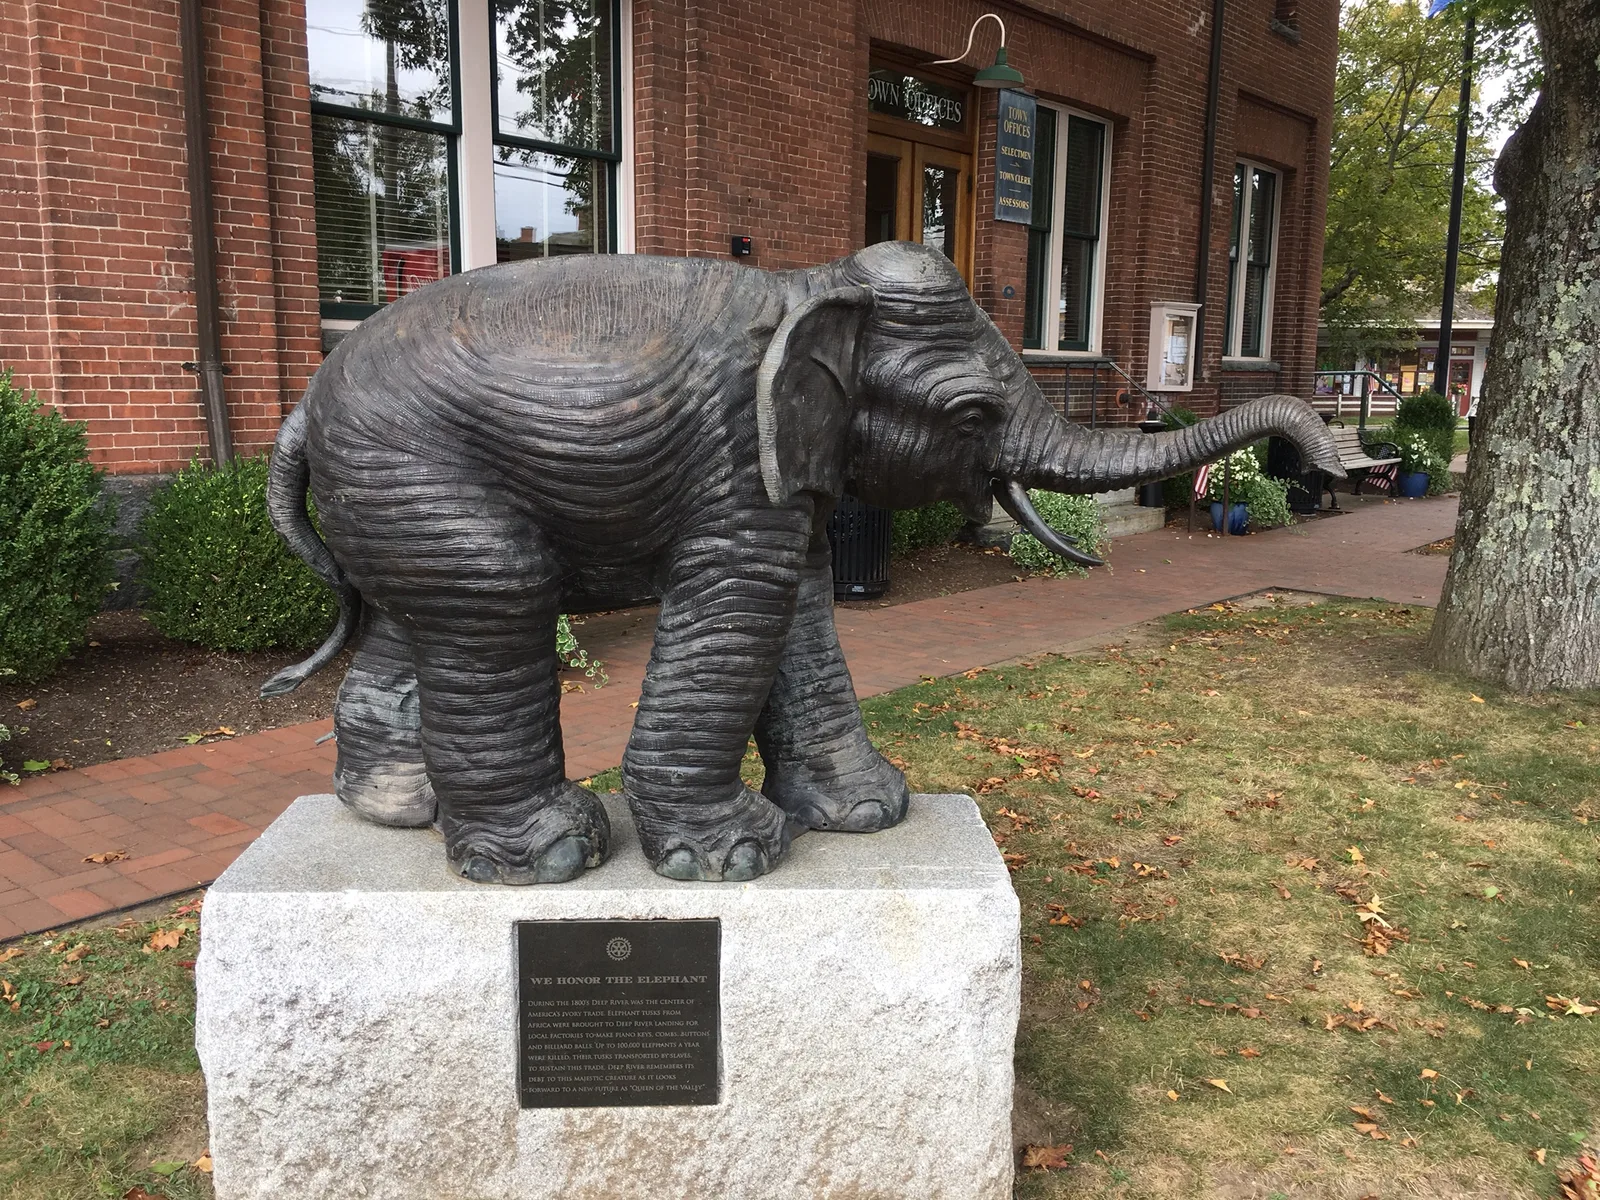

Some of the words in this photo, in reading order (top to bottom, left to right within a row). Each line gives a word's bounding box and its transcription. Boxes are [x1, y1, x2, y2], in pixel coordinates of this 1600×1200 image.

[868, 77, 900, 106] OWN
[906, 88, 962, 122] OFFICES
[1008, 106, 1028, 121] TOWN
[1003, 120, 1031, 138] OFFICES
[1001, 145, 1032, 160] SELECTMEN
[999, 170, 1015, 182] TOWN
[1015, 174, 1032, 186] CLERK
[998, 196, 1030, 210] ASSESSORS
[530, 977, 552, 985] WE
[556, 976, 601, 985] HONOR
[605, 976, 633, 984] THE
[637, 975, 708, 984] ELEPHANT
